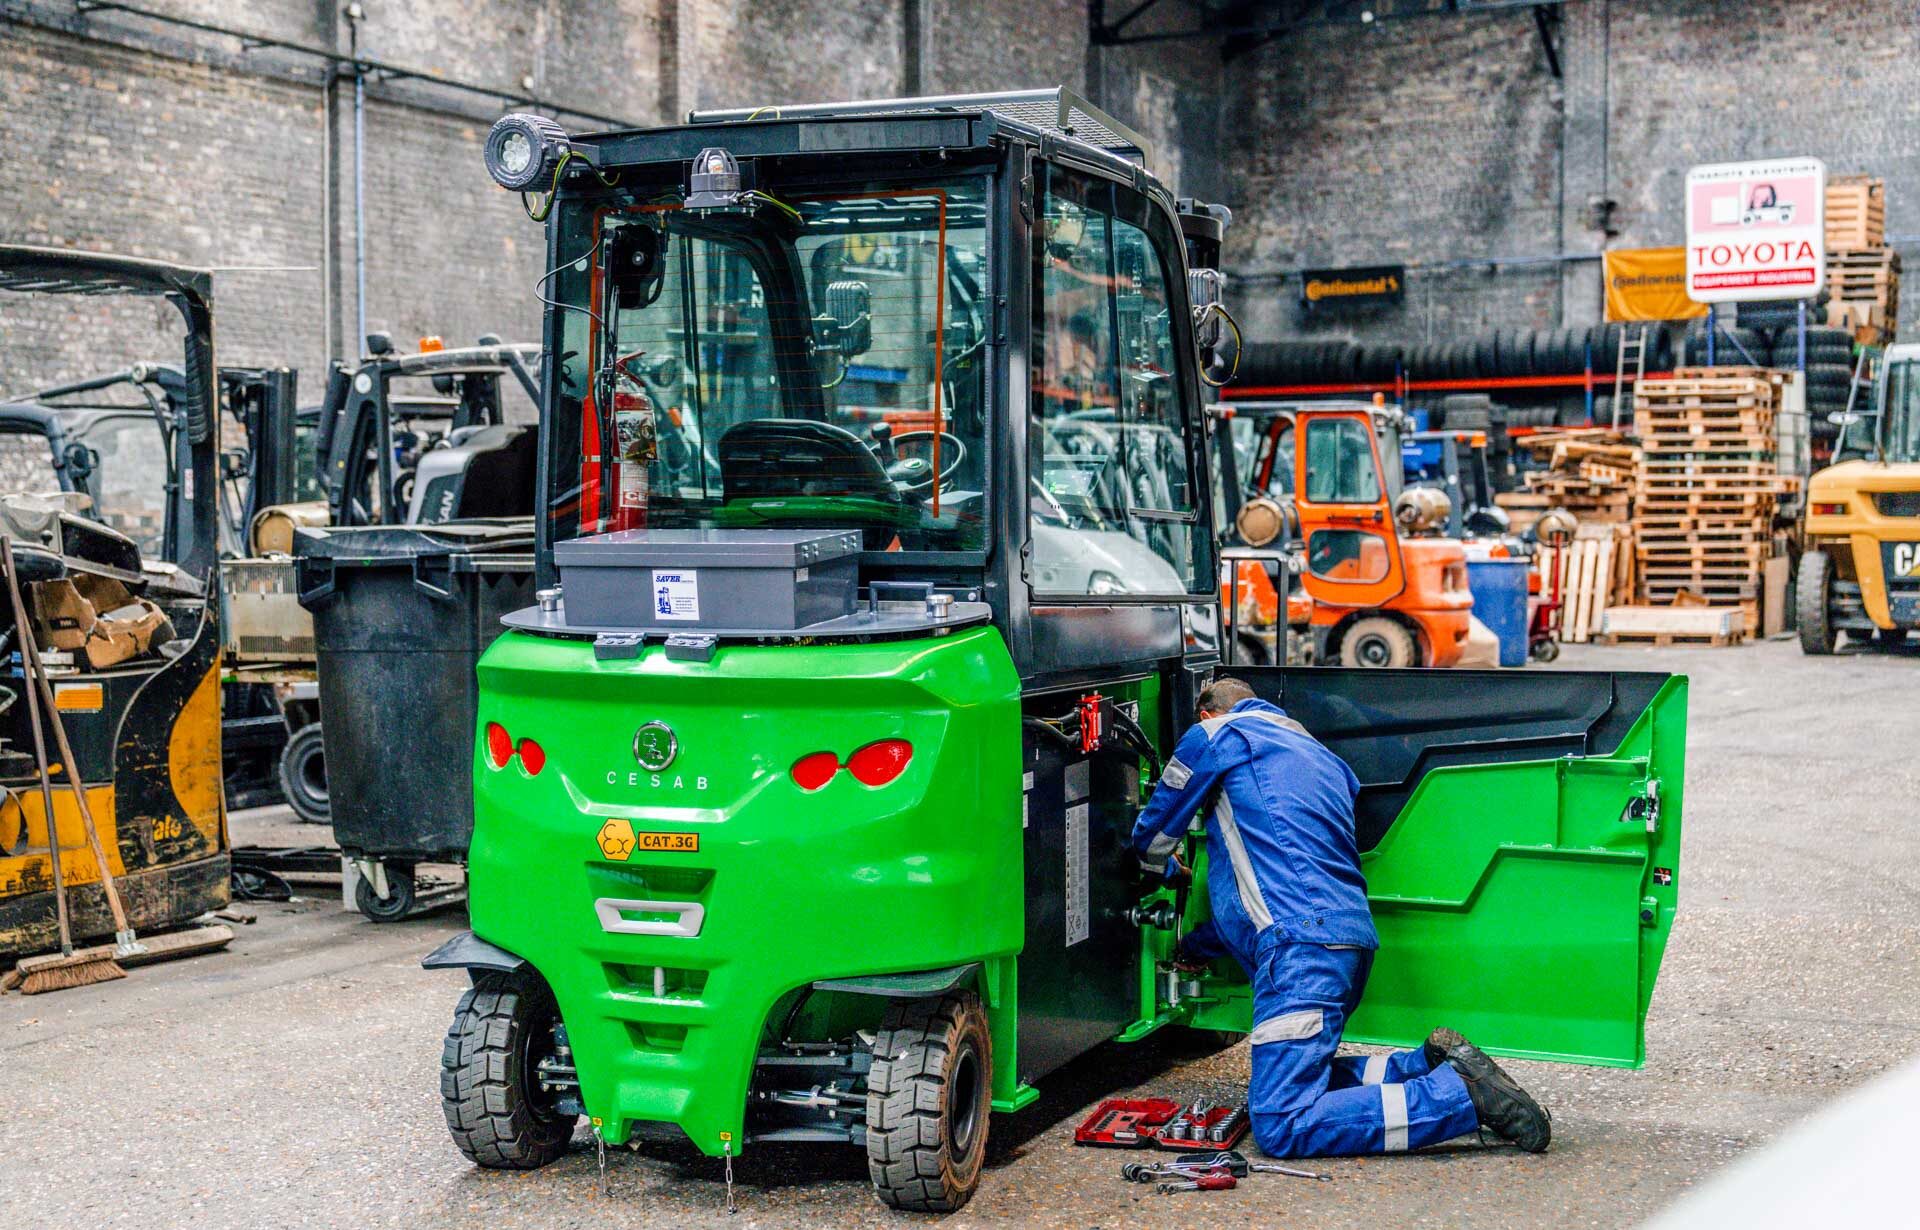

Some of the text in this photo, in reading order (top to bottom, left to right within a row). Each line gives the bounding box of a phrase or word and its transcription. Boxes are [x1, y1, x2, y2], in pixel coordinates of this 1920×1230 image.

[1692, 241, 1815, 266] TOYOTA
[655, 575, 681, 583] SAVER
[606, 771, 708, 790] CESAB
[643, 835, 693, 849] CAT.3G
